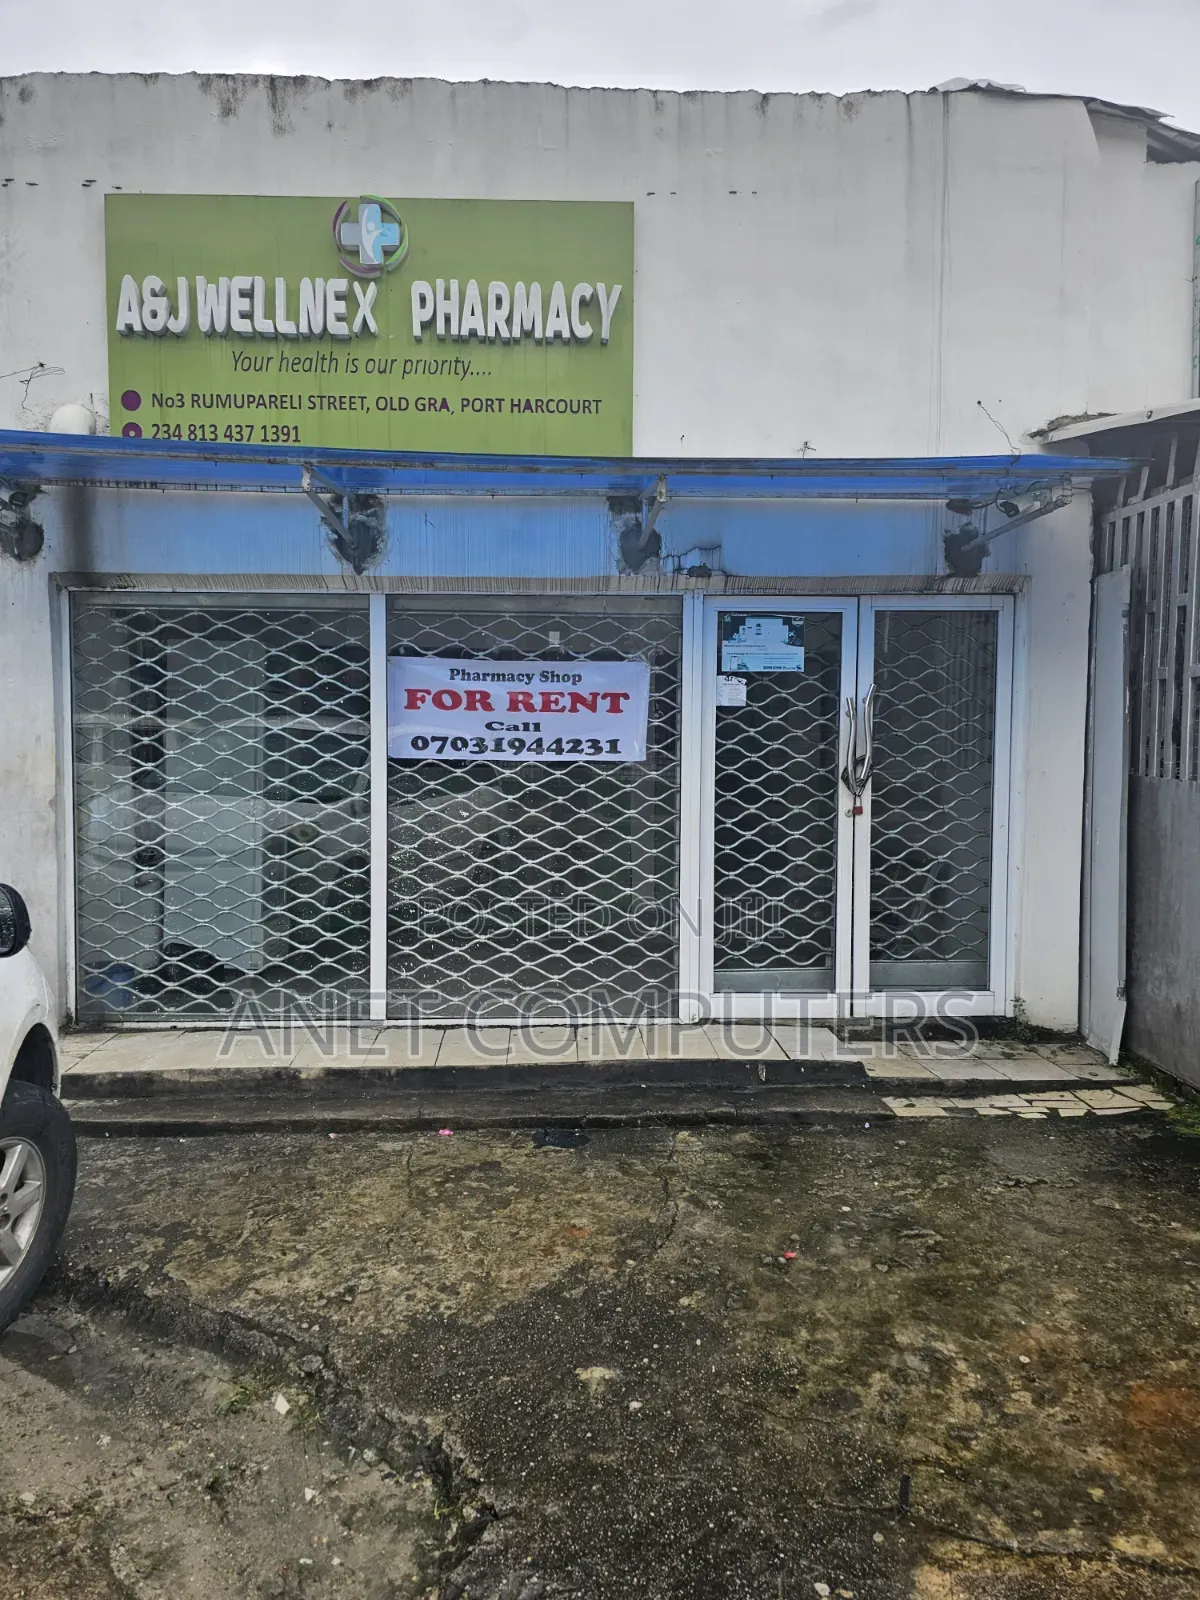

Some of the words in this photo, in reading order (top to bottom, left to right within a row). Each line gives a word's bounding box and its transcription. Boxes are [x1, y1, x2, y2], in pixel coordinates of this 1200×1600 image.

[116, 274, 190, 337] A&J
[196, 275, 378, 340] WELLNEX
[411, 278, 622, 345] PHARMACY
[232, 351, 274, 373] Your
[279, 350, 339, 374] health
[345, 352, 359, 374] is
[365, 358, 397, 376] our
[151, 393, 186, 409] No3
[191, 394, 302, 410] RUMUPARELI
[307, 395, 370, 414] STREET,
[375, 397, 409, 412] OLD
[415, 397, 455, 416] GRA,
[461, 398, 505, 413] PORT
[510, 398, 602, 414] HARCOURT
[151, 424, 183, 441] 234
[188, 424, 218, 442] 813
[223, 425, 255, 442] 437
[260, 425, 301, 443] 1391
[449, 668, 536, 685] Pharmacy
[539, 670, 583, 685] Shop
[404, 688, 496, 711] FOR
[506, 690, 631, 714] RENT
[485, 721, 542, 732] Call
[410, 735, 622, 756] 07031944231
